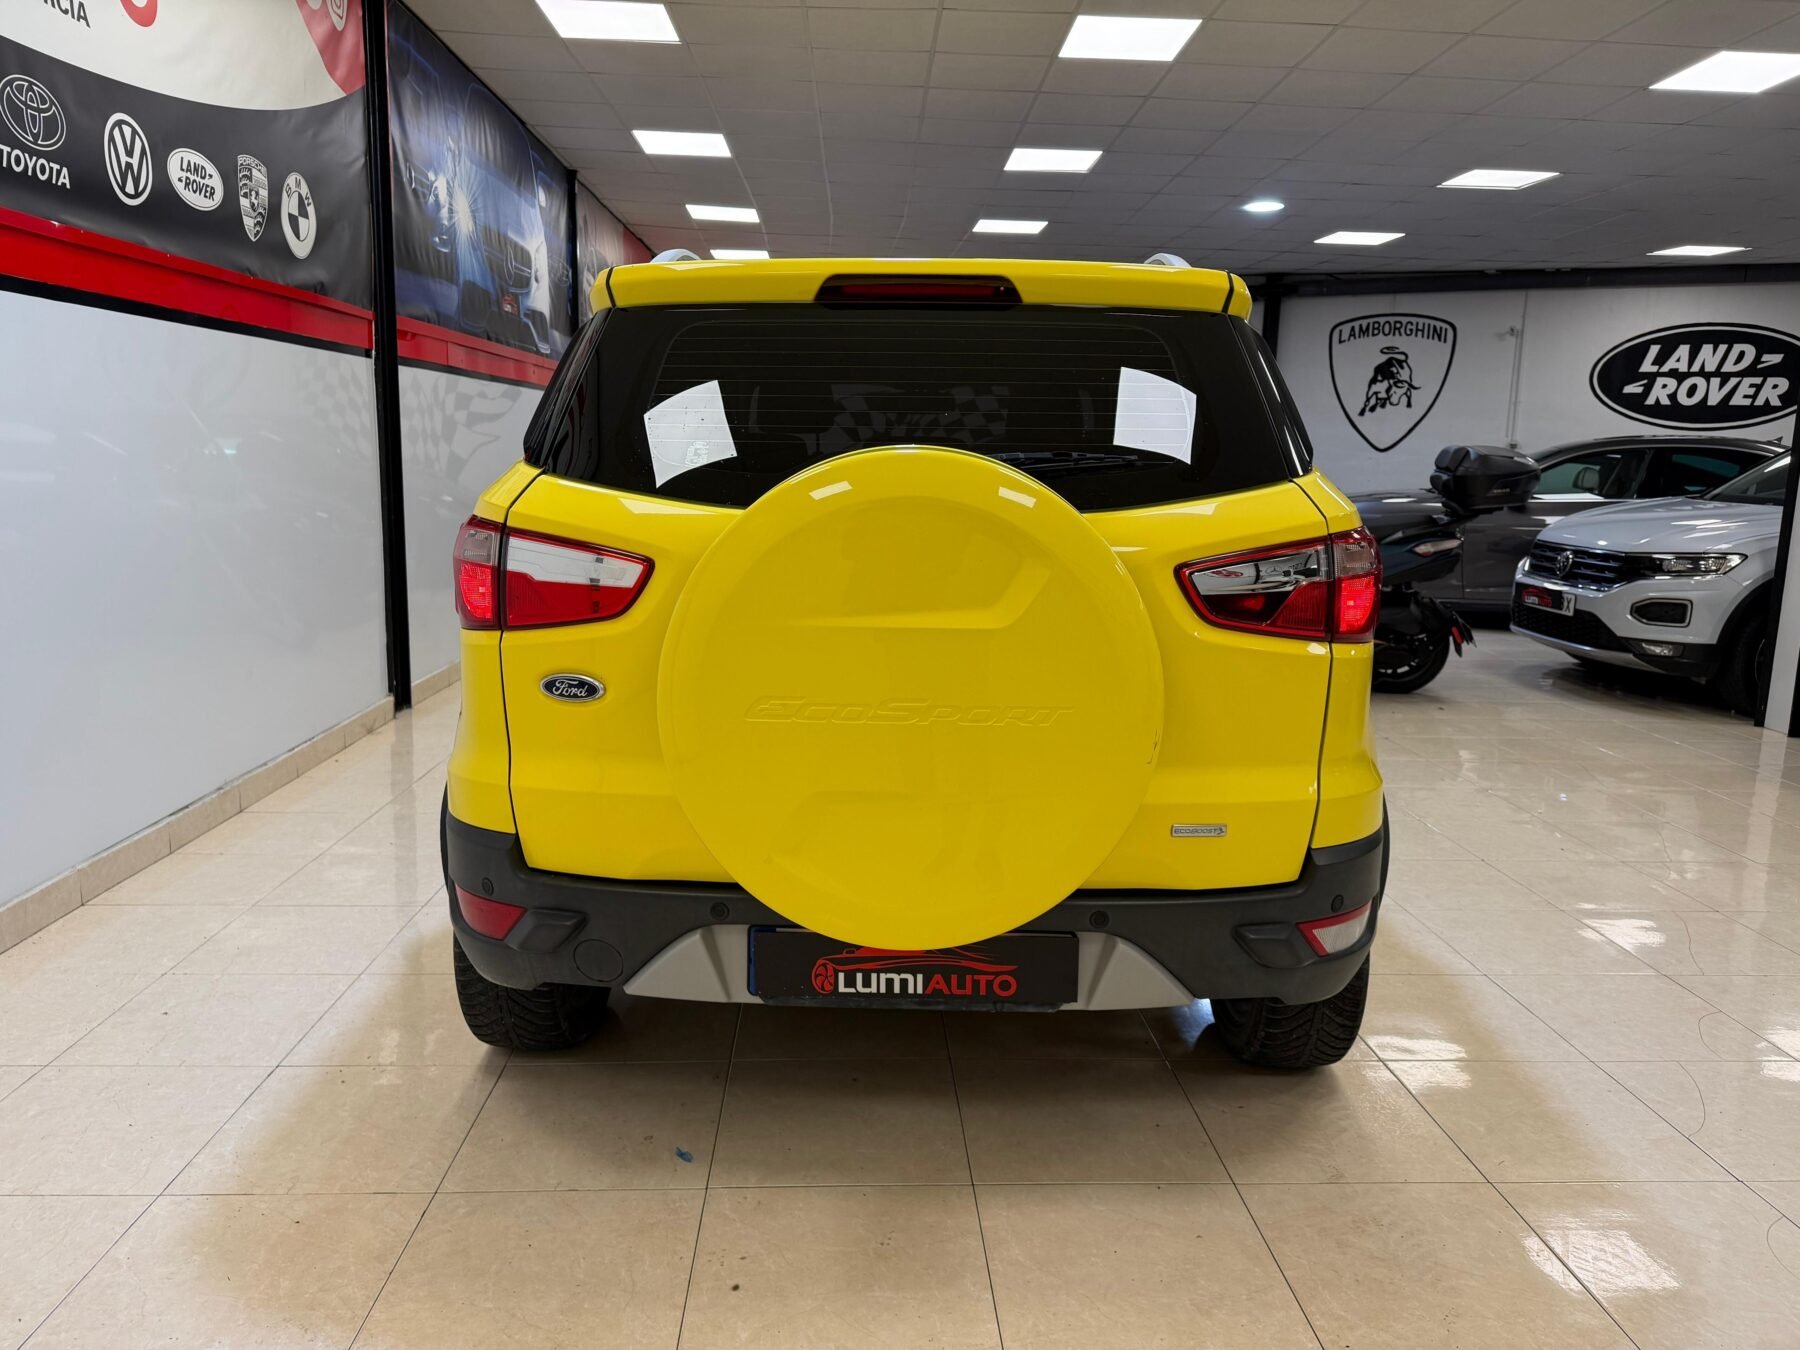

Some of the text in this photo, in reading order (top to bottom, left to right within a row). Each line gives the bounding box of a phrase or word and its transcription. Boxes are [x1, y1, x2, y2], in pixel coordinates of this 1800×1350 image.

[0, 144, 71, 189] TOYOTA
[180, 156, 207, 181] LAND
[184, 176, 216, 202] ROVER
[285, 177, 312, 207] BMW
[1338, 320, 1448, 344] LAMBORGHINI
[1638, 343, 1757, 373] LAND
[1644, 376, 1790, 406] ROVER
[553, 679, 588, 697] Ford
